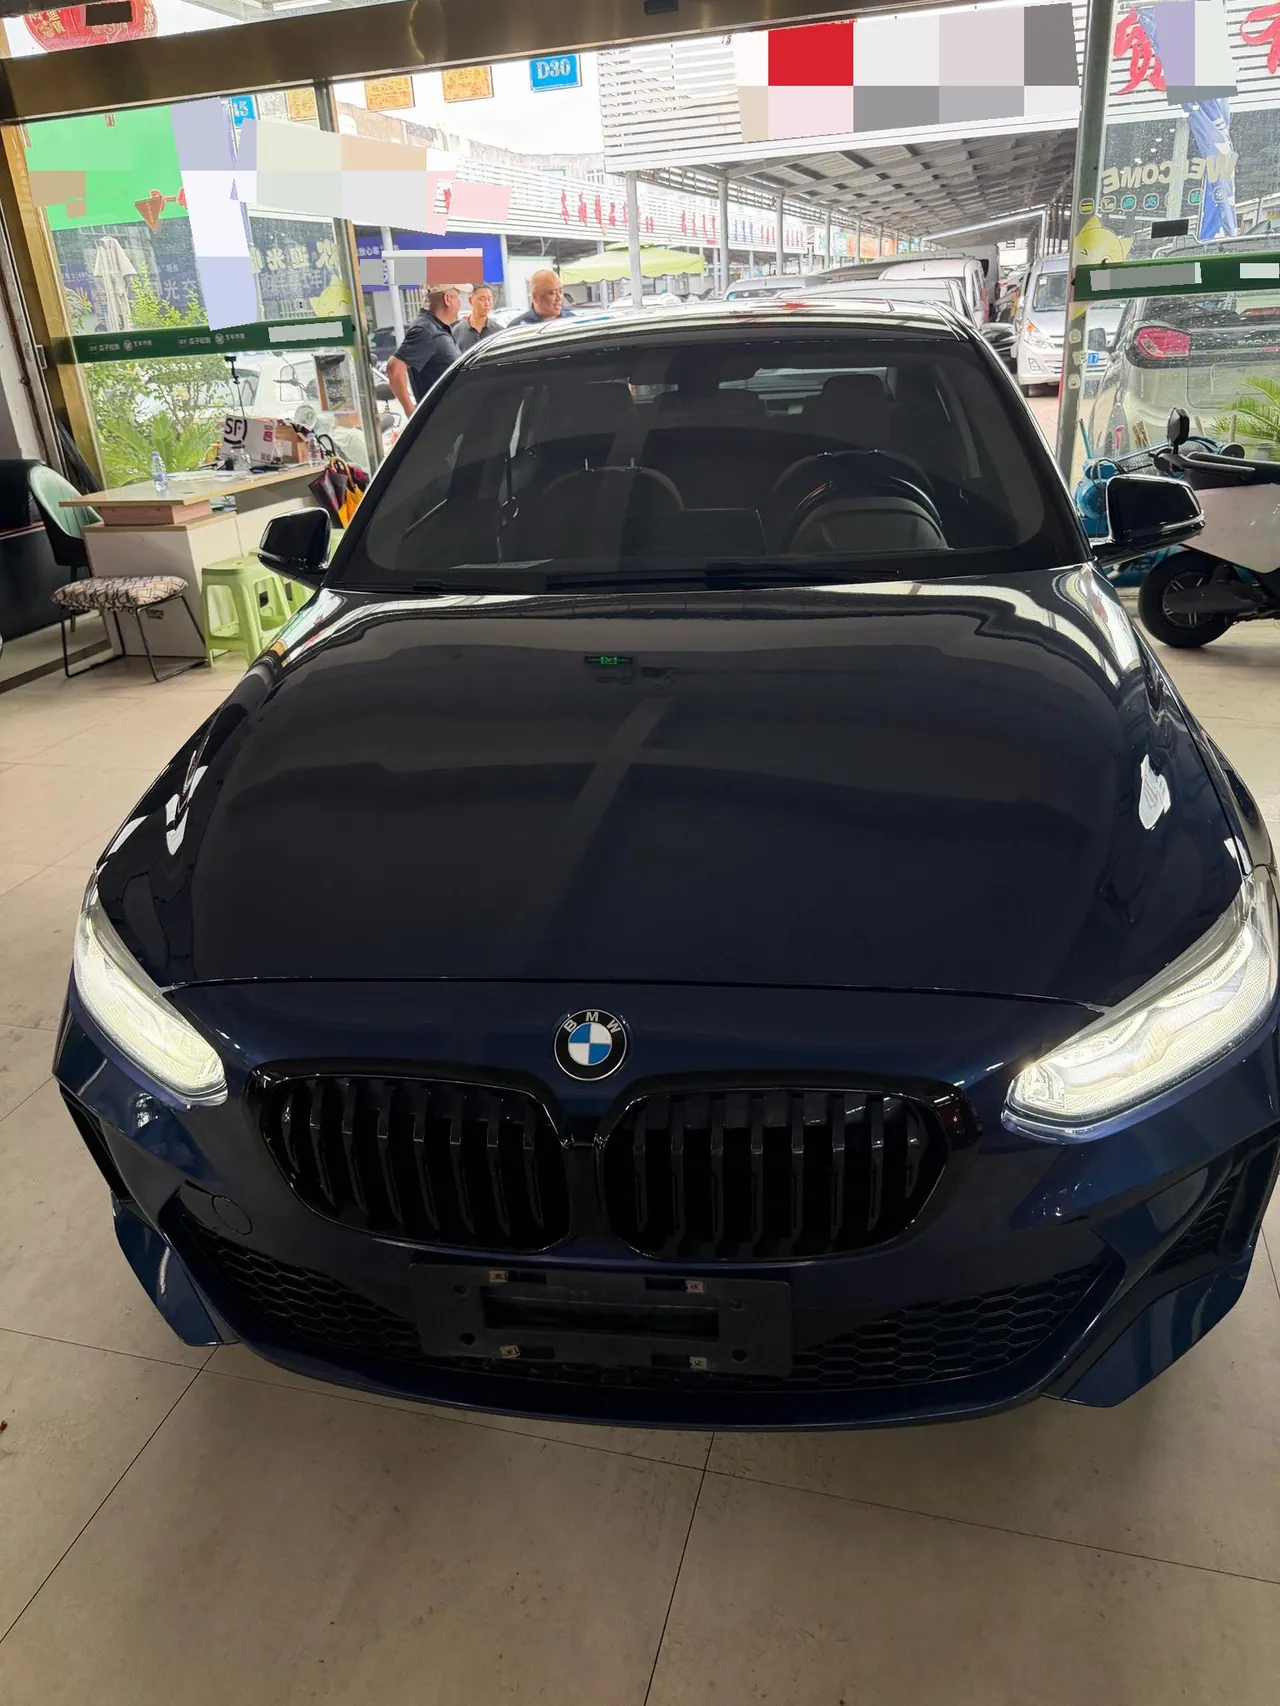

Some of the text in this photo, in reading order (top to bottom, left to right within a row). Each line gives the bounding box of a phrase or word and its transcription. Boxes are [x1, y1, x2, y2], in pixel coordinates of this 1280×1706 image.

[536, 58, 571, 80] D30
[225, 417, 244, 437] SF
[563, 1011, 622, 1034] BMW
